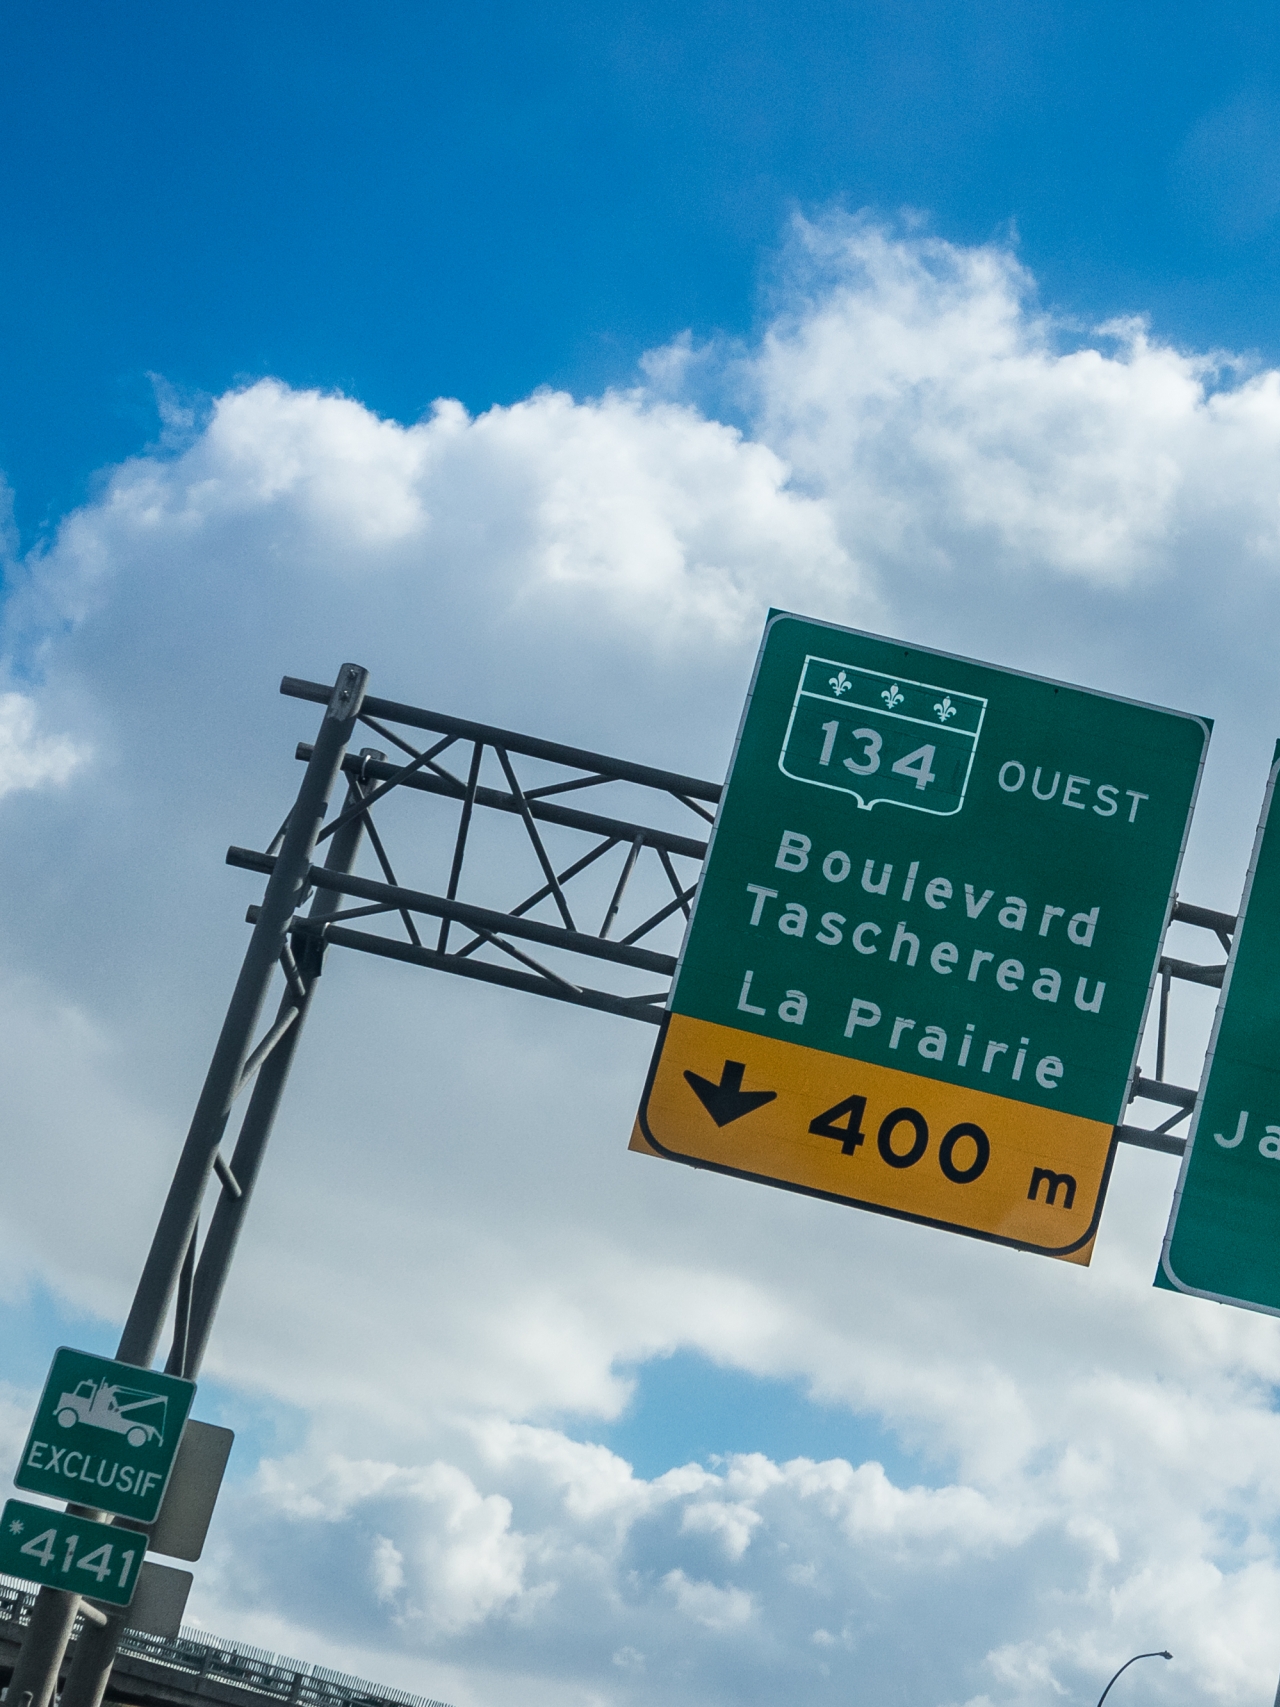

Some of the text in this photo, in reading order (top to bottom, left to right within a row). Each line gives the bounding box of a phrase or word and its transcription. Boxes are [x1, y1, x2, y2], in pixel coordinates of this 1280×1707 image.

[819, 720, 936, 790] 134
[998, 760, 1149, 822] OUEST
[774, 830, 1100, 949] Boulevard
[745, 883, 1107, 1014] Taschereau
[737, 970, 1065, 1089] La Prairie
[808, 1094, 1077, 1209] 400 m
[27, 1441, 162, 1497] EXCLUSIF
